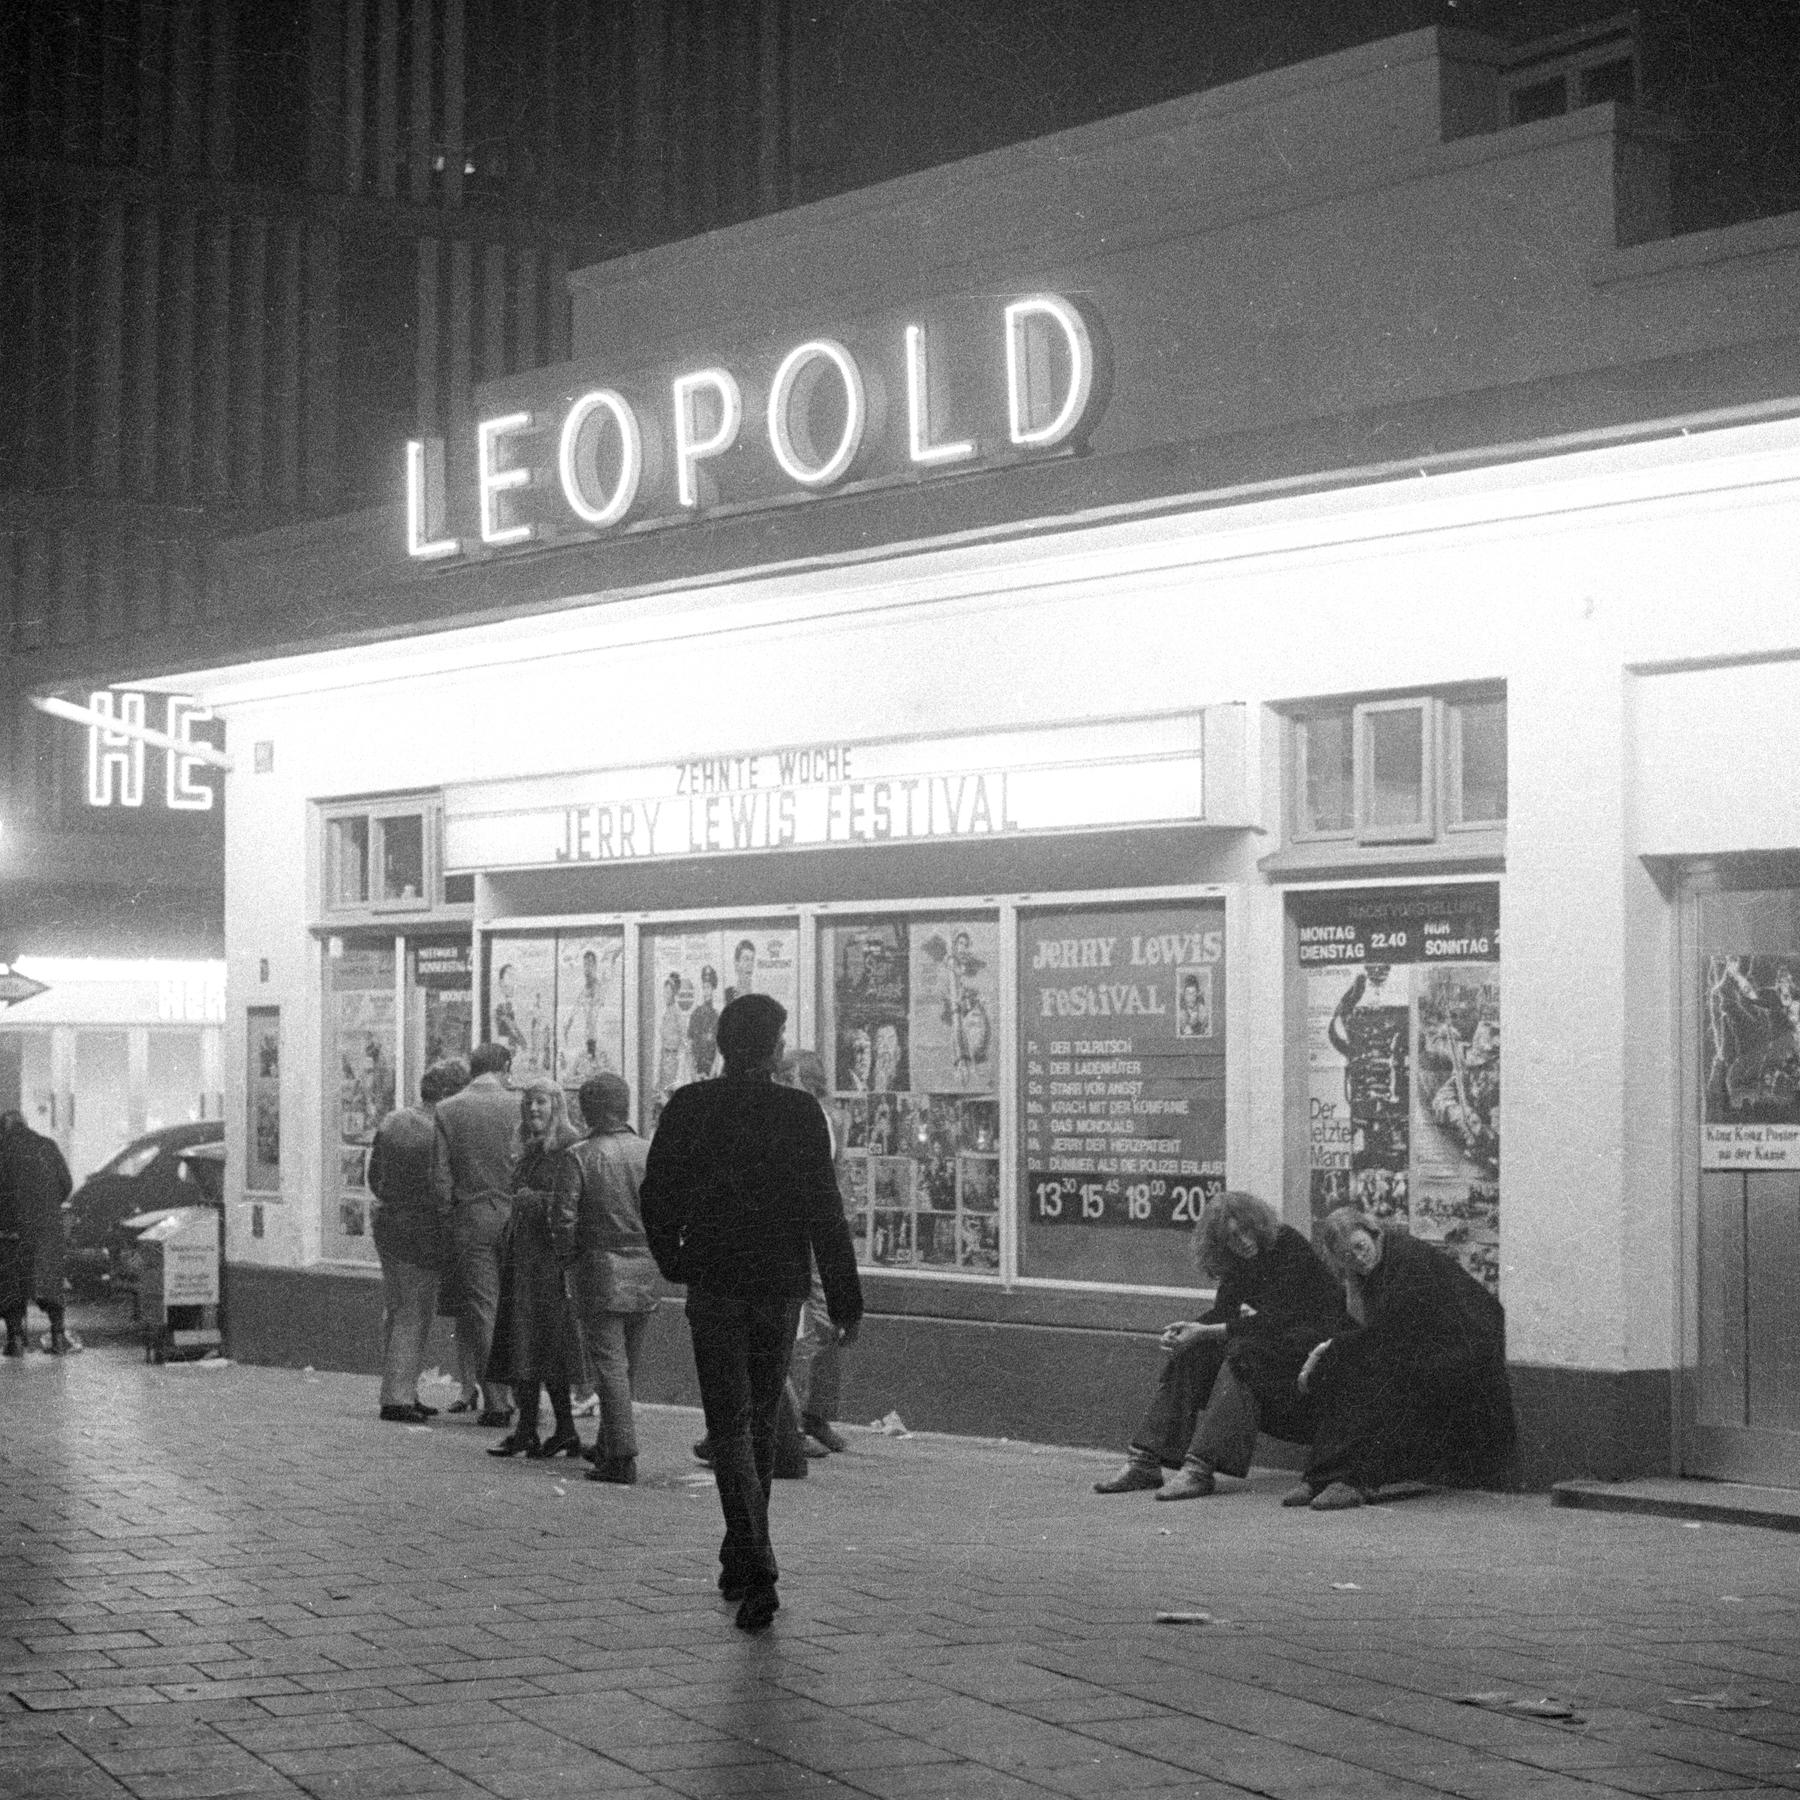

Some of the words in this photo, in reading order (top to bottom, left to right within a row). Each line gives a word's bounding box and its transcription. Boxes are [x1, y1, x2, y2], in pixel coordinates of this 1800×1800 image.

[408, 294, 1091, 557] LEOPOLD
[676, 754, 760, 796] ZEHNTE
[779, 747, 854, 786] WOCHE
[556, 801, 662, 863] JERRY
[689, 791, 797, 855] LEWIS
[826, 771, 1018, 845] FESTIVAL
[1300, 925, 1356, 942] MONTAG
[1371, 931, 1407, 949] 22.40
[1300, 943, 1365, 960] DIENSTAG
[1425, 938, 1489, 956] SONNTAG
[1050, 1041, 1071, 1054] DER
[1051, 1061, 1071, 1075] DER
[1310, 1097, 1337, 1120] Der
